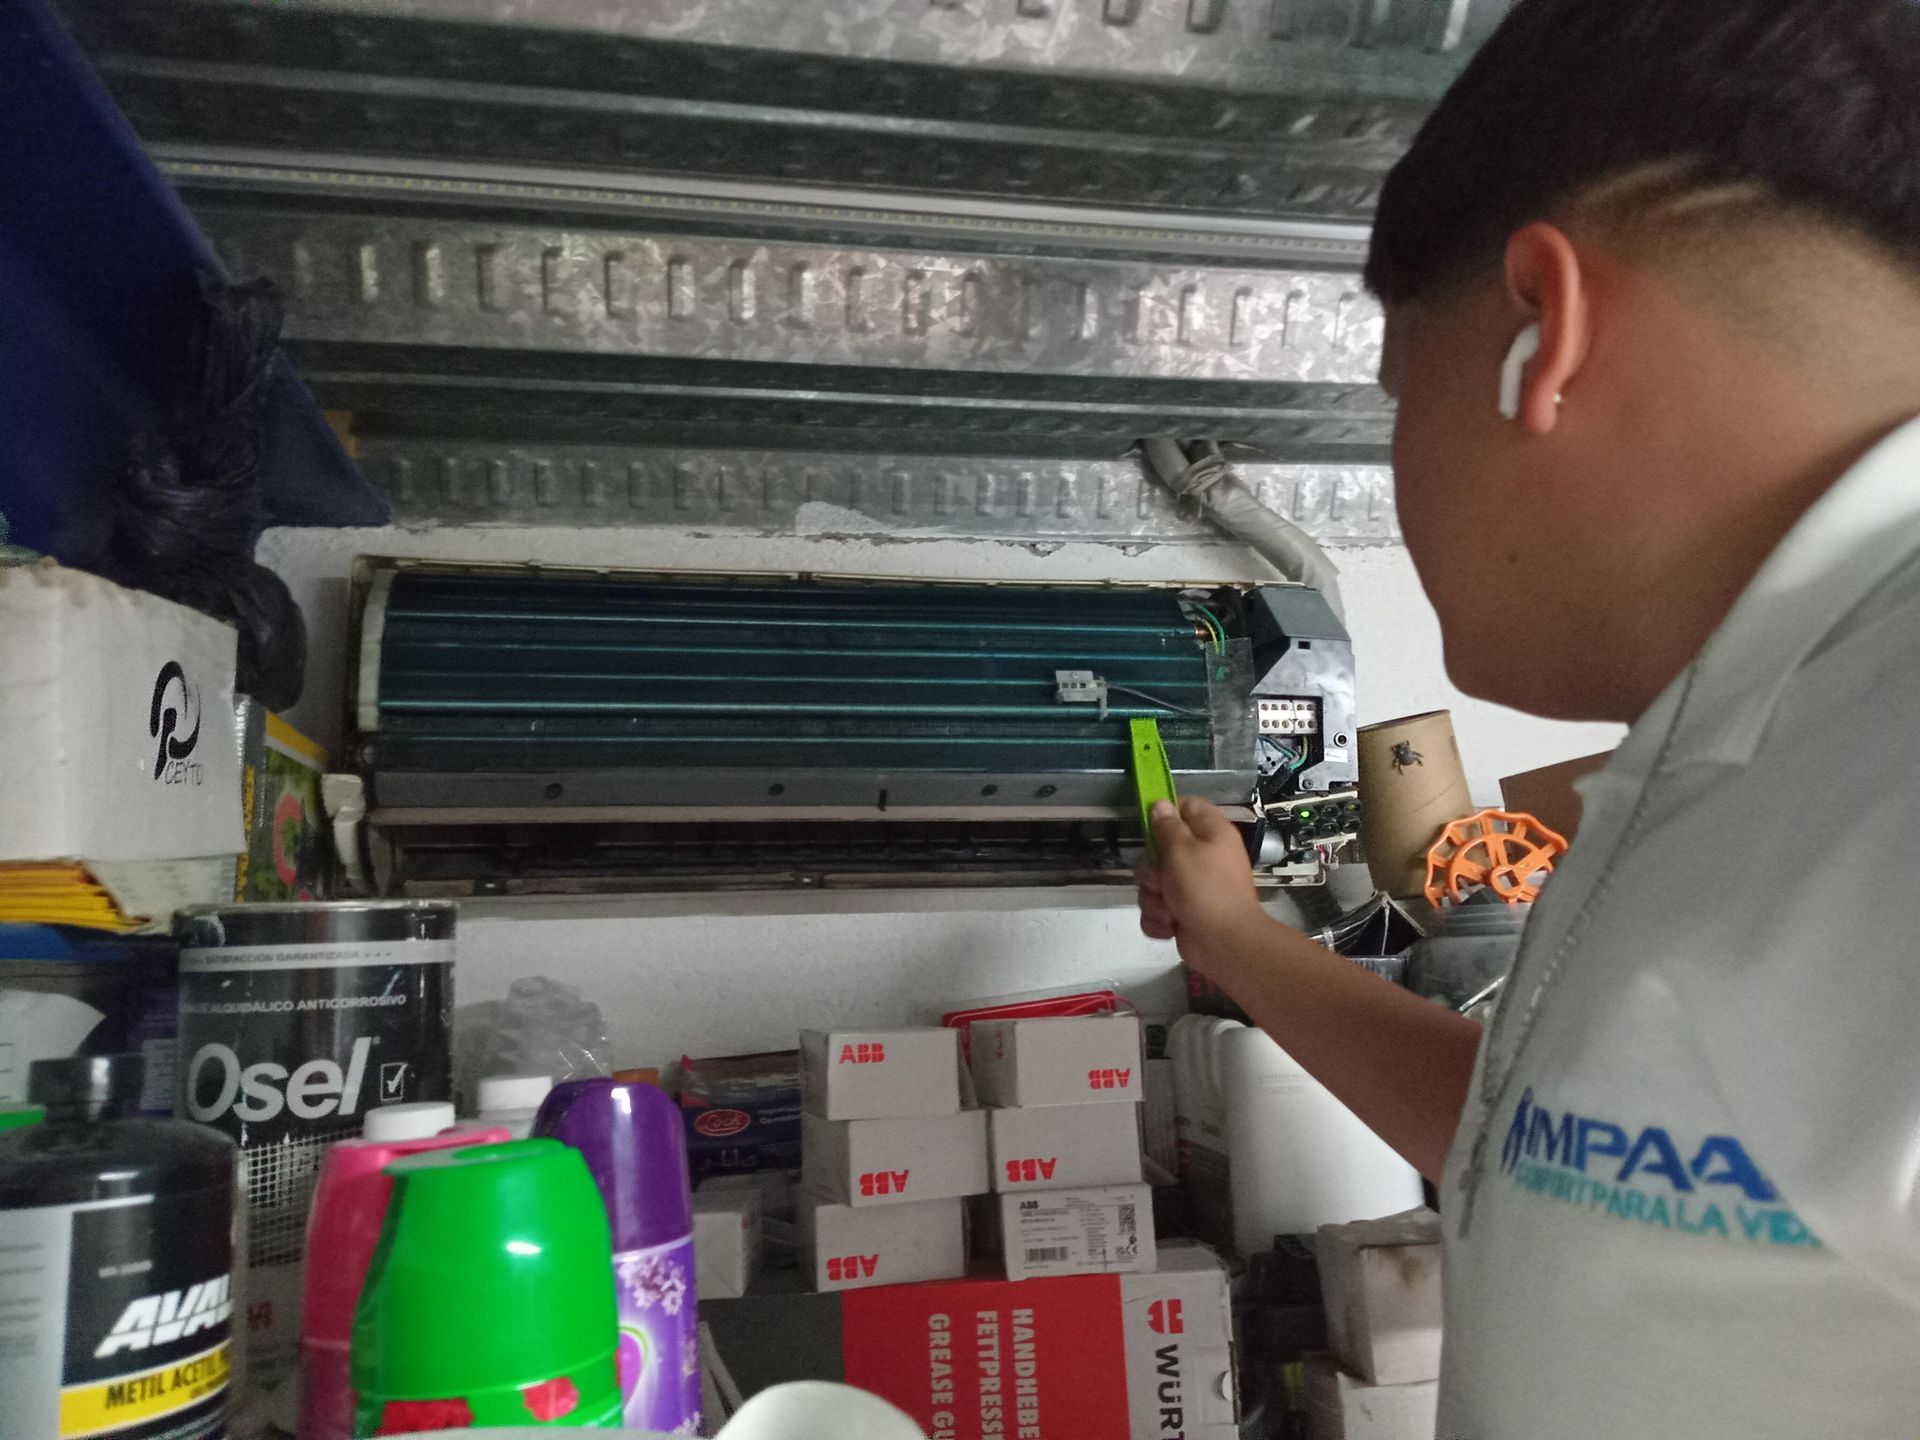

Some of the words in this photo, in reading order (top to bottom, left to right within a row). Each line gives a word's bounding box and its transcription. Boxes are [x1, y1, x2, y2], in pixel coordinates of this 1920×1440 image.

[276, 948, 359, 963] GARANTIZADA
[296, 994, 406, 1011] ANTICORROSIVO
[839, 1043, 885, 1064] ABB
[187, 1036, 371, 1122] Osel
[1088, 1068, 1131, 1089] ABB
[859, 1169, 909, 1196] ABB
[1006, 1157, 1056, 1182] ABB
[1020, 1200, 1039, 1210] ABB
[1591, 1179, 1670, 1228] PARA
[1676, 1198, 1728, 1235] LA
[826, 1254, 879, 1281] ABB
[928, 1313, 954, 1405] GREASE
[105, 1373, 166, 1409] METIL
